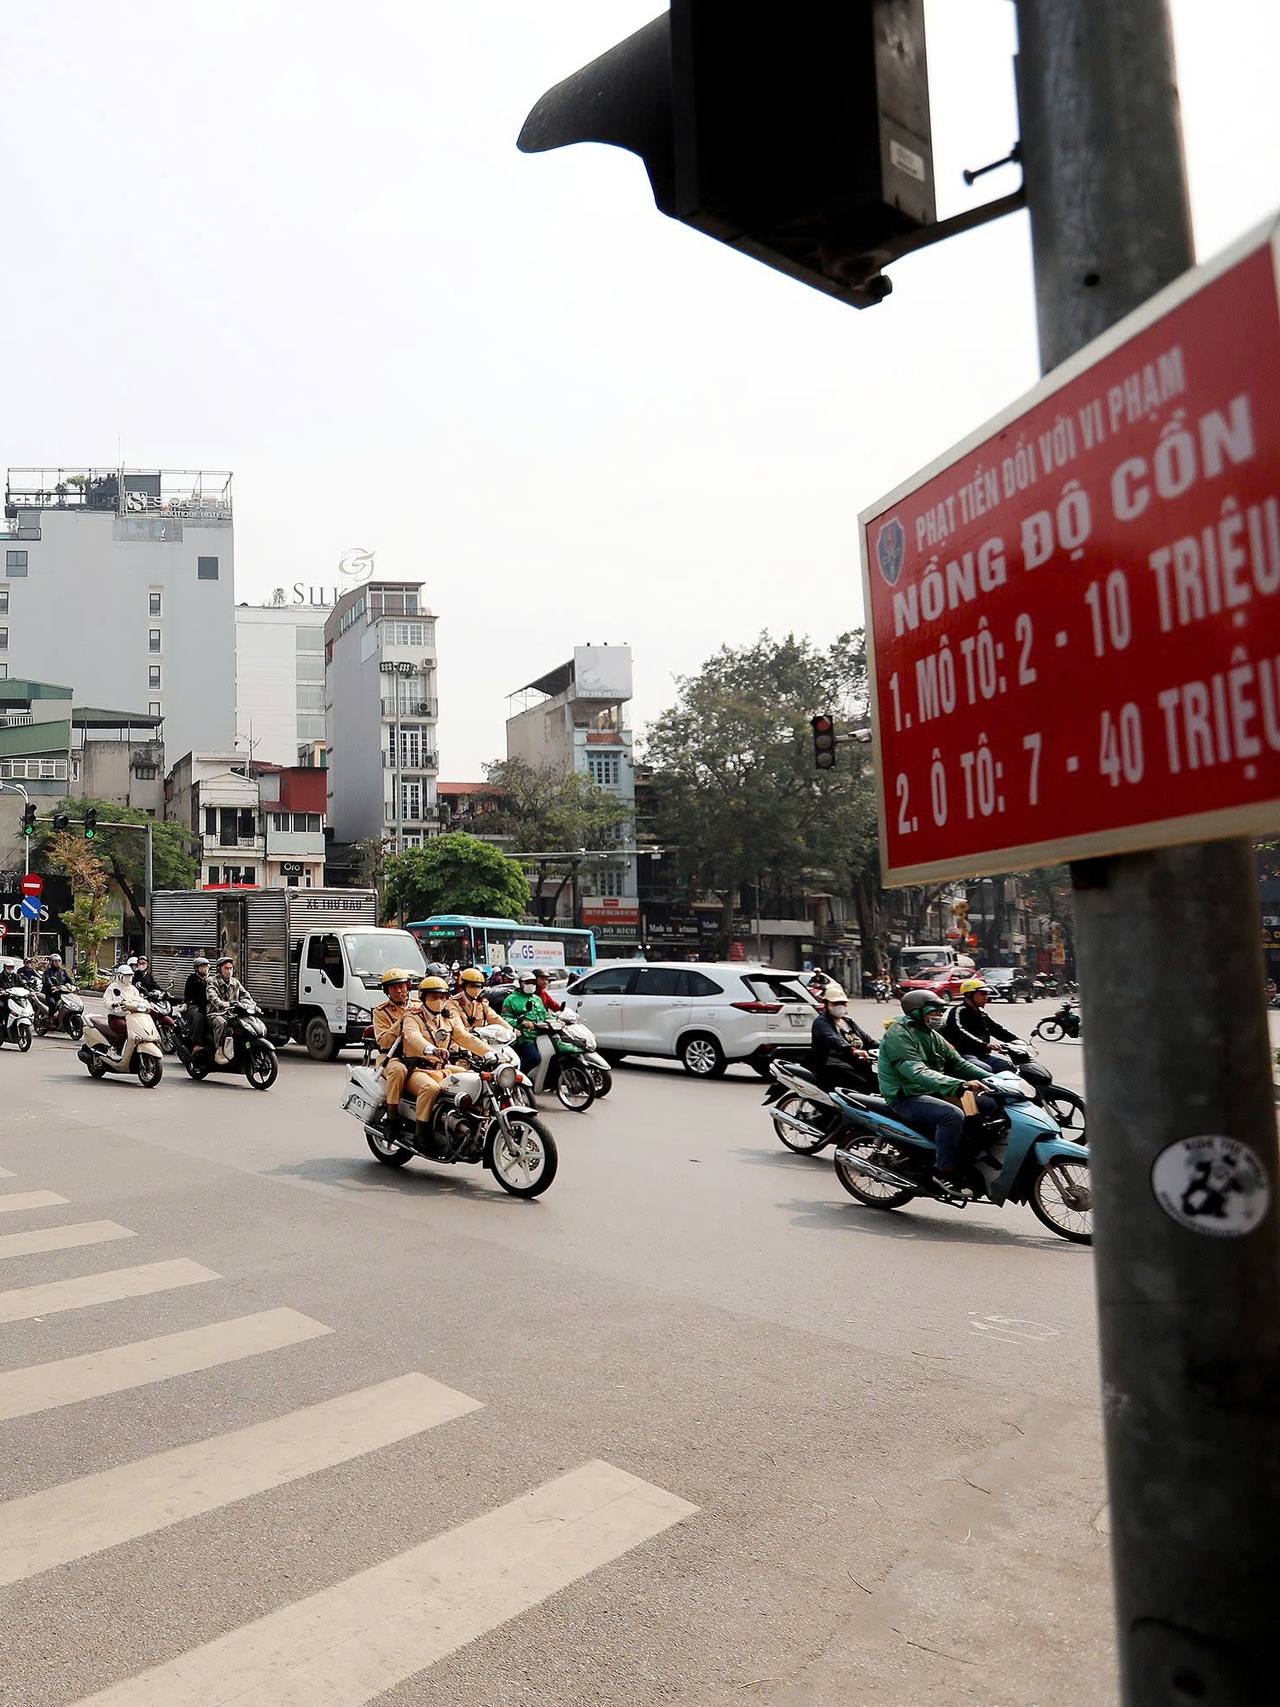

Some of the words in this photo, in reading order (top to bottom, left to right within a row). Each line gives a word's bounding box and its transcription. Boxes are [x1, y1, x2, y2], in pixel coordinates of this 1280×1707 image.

[160, 510, 199, 518] BOUTIQUE
[916, 495, 955, 552] PHẠT
[1079, 398, 1104, 451] VI
[1107, 344, 1185, 434] PHẠM
[1021, 480, 1091, 571] ĐỘ
[889, 672, 912, 732] 1.
[916, 635, 956, 723] MÔ
[960, 615, 1007, 705] TÔ:
[1015, 612, 1037, 686] 2
[1084, 569, 1131, 657] 10
[1149, 496, 1280, 633] TRIỆU
[896, 772, 918, 835] 2.
[930, 747, 948, 827] Ô
[960, 732, 1006, 819] TÔ:
[1023, 732, 1042, 806] 7
[1099, 702, 1144, 787] 40
[1158, 645, 1280, 780] TRIỆU
[522, 945, 535, 959] GS
